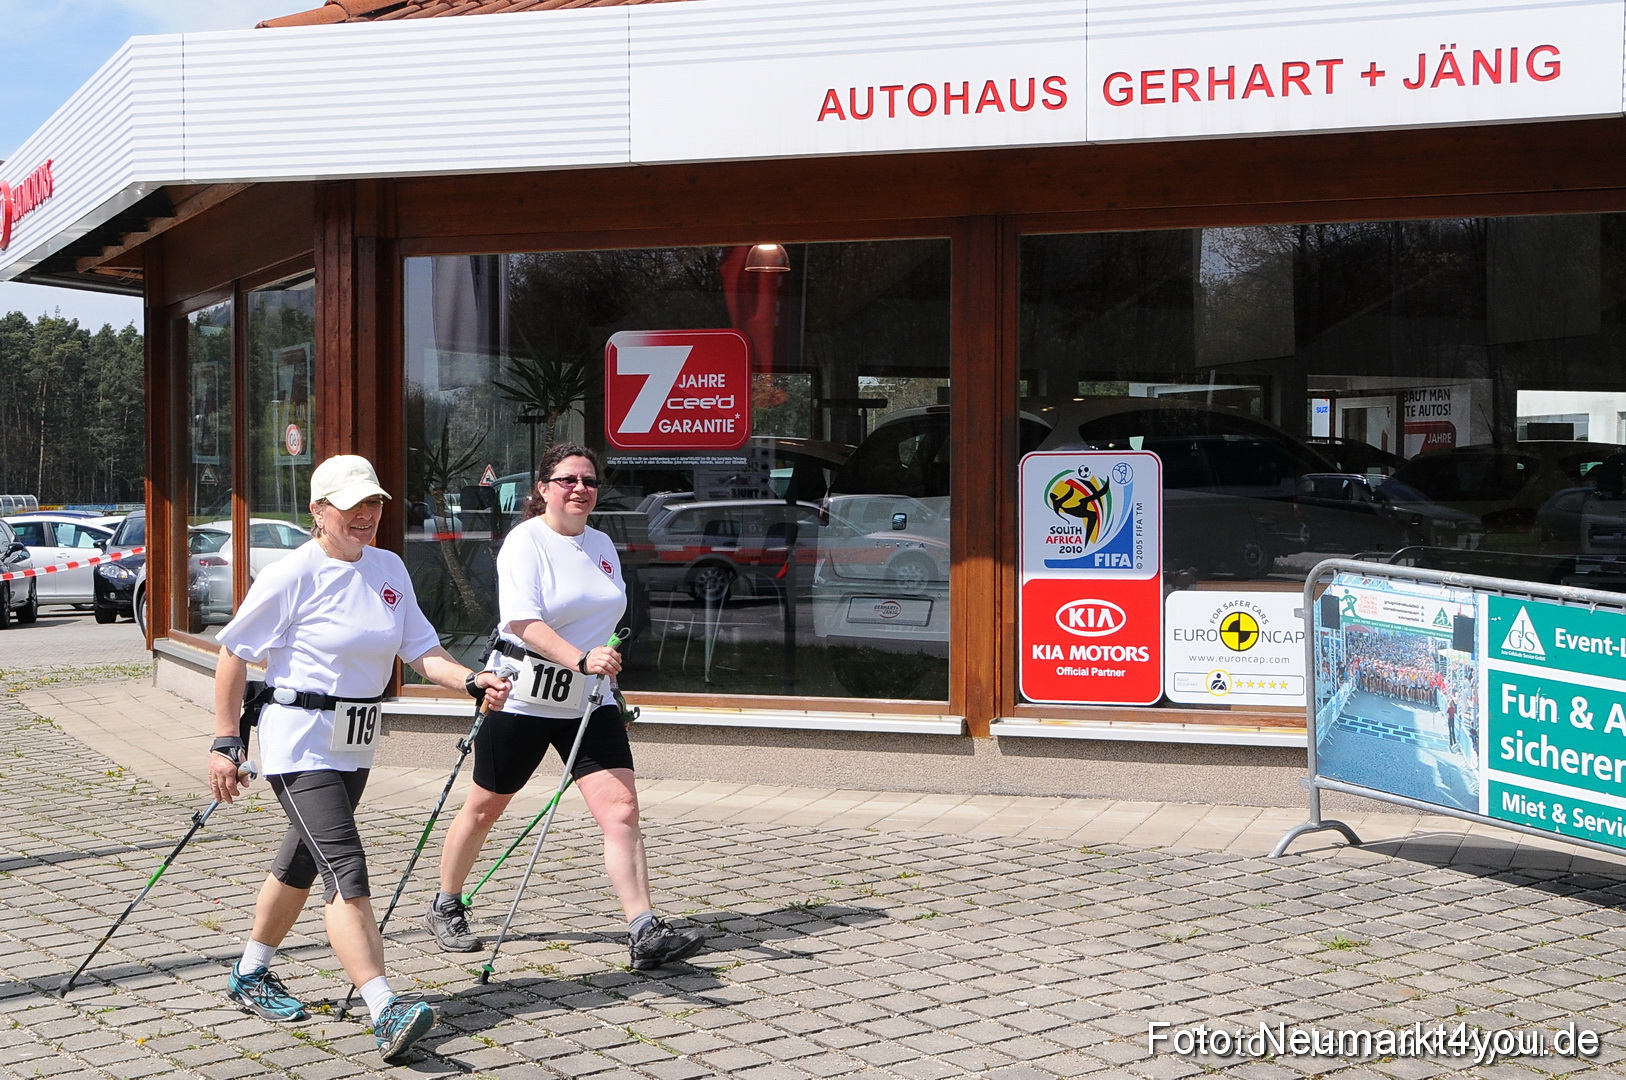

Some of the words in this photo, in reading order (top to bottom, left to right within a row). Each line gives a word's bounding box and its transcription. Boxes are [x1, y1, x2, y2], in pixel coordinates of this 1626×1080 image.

[817, 75, 1068, 122] AUTOHAUS
[1102, 58, 1344, 107] GERHART
[1360, 61, 1386, 87] +
[1403, 43, 1562, 90] JÄNIG
[678, 374, 726, 388] JAHRE
[617, 345, 694, 433] 7
[1430, 389, 1450, 401] MAN
[667, 394, 735, 410] cee'd
[1418, 404, 1452, 417] AUTOS!
[1427, 433, 1452, 444] JAHRE
[1136, 502, 1143, 516] TM
[1049, 525, 1083, 535] SOUTH
[1045, 535, 1083, 545] AFRICA
[1058, 545, 1083, 554] 2010
[1094, 553, 1132, 567] FIFA
[1068, 608, 1115, 628] KIA
[1210, 607, 1223, 625] FOR
[1222, 600, 1251, 611] SAFER
[1251, 604, 1270, 625] CARS
[1173, 628, 1218, 642] EURO
[1261, 630, 1305, 644] NCAP
[1032, 645, 1064, 660] KIA
[1069, 645, 1150, 662] MOTORS
[1188, 655, 1290, 665] www.euroncap.com
[1056, 666, 1089, 676] Official
[1091, 667, 1126, 677] Partner
[532, 663, 573, 703] 118
[1502, 683, 1558, 724] Fun
[1569, 696, 1595, 730] &
[1603, 703, 1626, 737] A
[346, 705, 378, 746] 119
[1502, 791, 1547, 820] Miet
[1551, 803, 1567, 825] &
